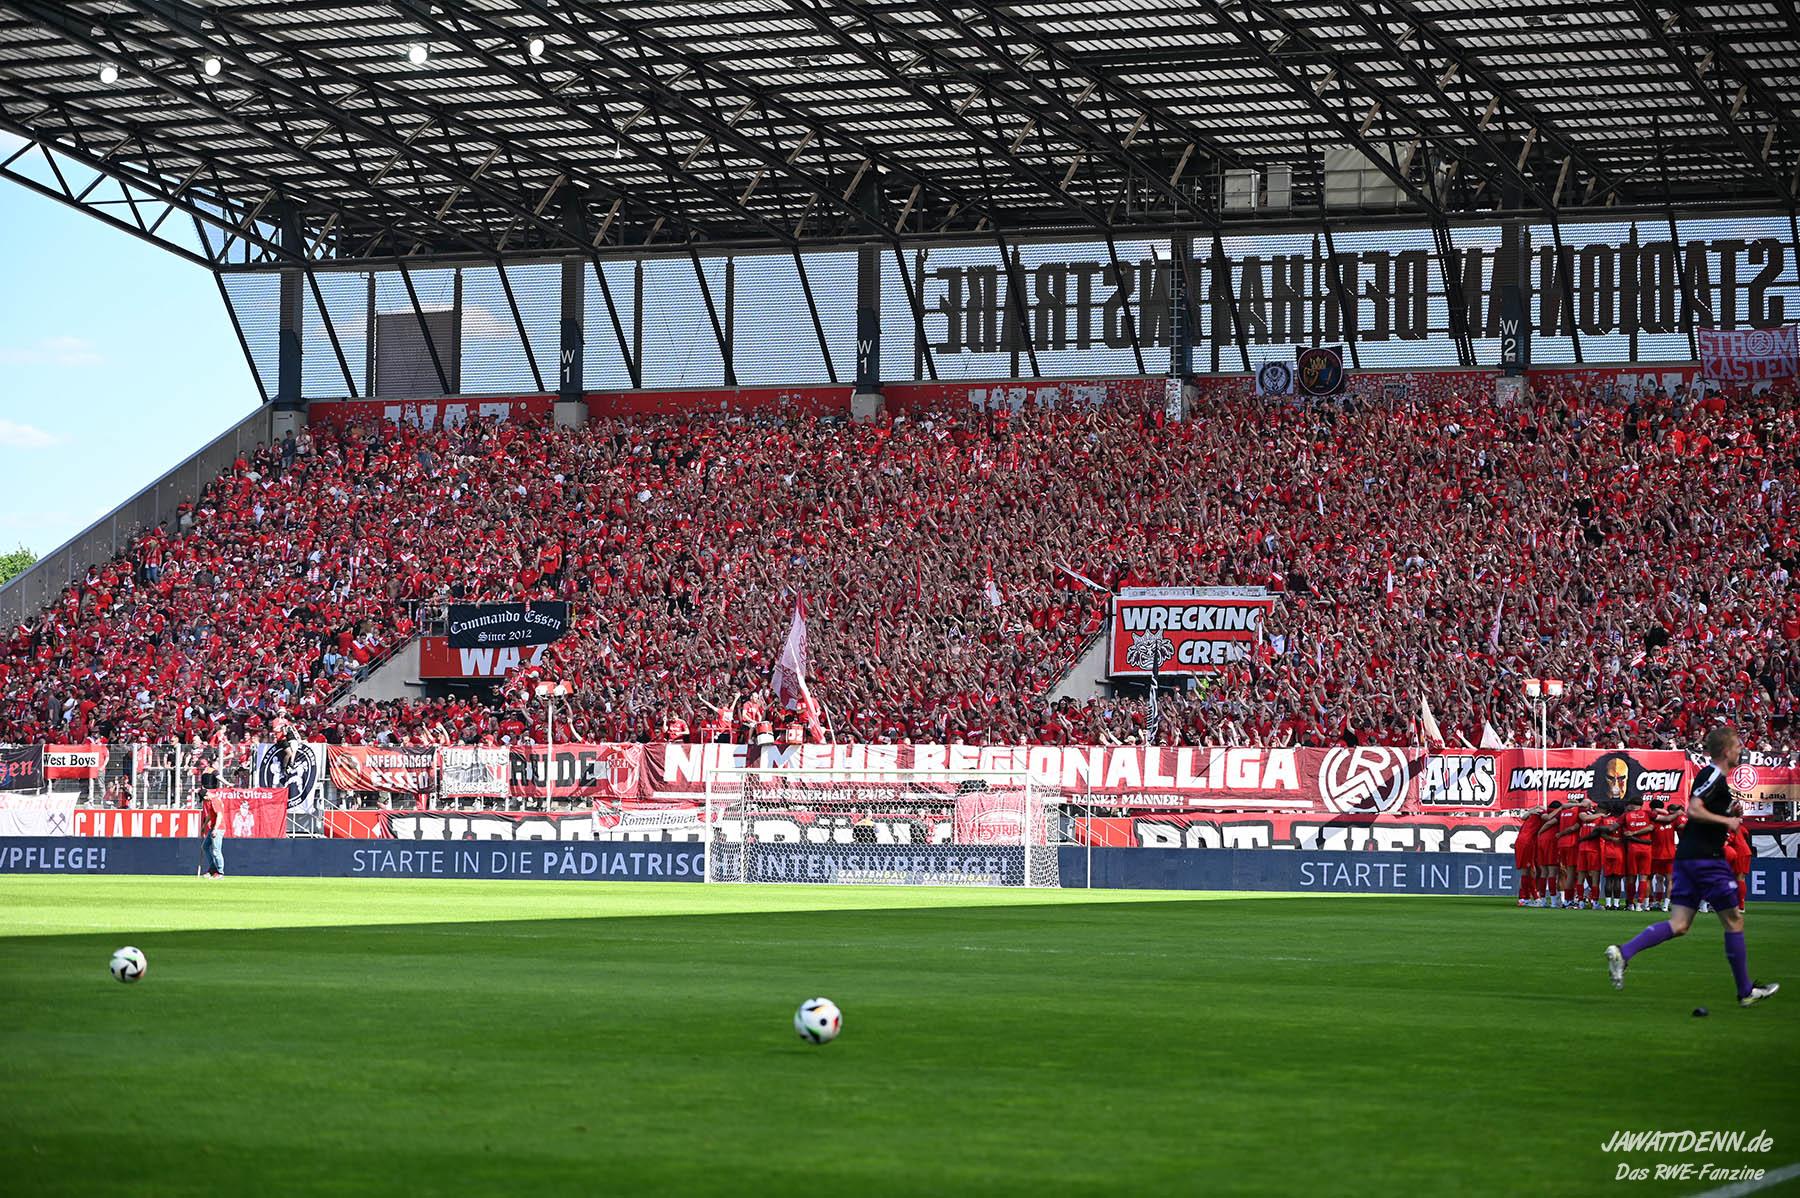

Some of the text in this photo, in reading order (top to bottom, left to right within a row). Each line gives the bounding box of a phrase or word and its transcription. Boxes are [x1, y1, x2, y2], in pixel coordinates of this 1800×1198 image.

[1502, 319, 1519, 356] W 2
[560, 349, 575, 383] W 1
[858, 340, 873, 375] W 1
[1702, 355, 1799, 380] KASTEN
[450, 609, 562, 635] Commando Essen
[1122, 606, 1266, 631] WRECKING
[477, 629, 533, 643] Since 2012
[44, 753, 97, 767] West Boys
[509, 751, 597, 787] RUDE
[664, 743, 1300, 790] NIE MEHR REGIONALLIGA
[1420, 755, 1496, 806] AKS
[1509, 768, 1596, 790] NORTHSIDE
[1636, 771, 1681, 792] CREW
[1071, 792, 1184, 806] DANKE MÄNNER!
[620, 811, 697, 827] Kommilitonen
[352, 849, 444, 874] STARTE
[454, 850, 480, 874] IN
[491, 850, 533, 875] DIE
[838, 870, 992, 882] GARTENBAU GARTENBAU
[1299, 863, 1513, 889] STARTE IN DIE
